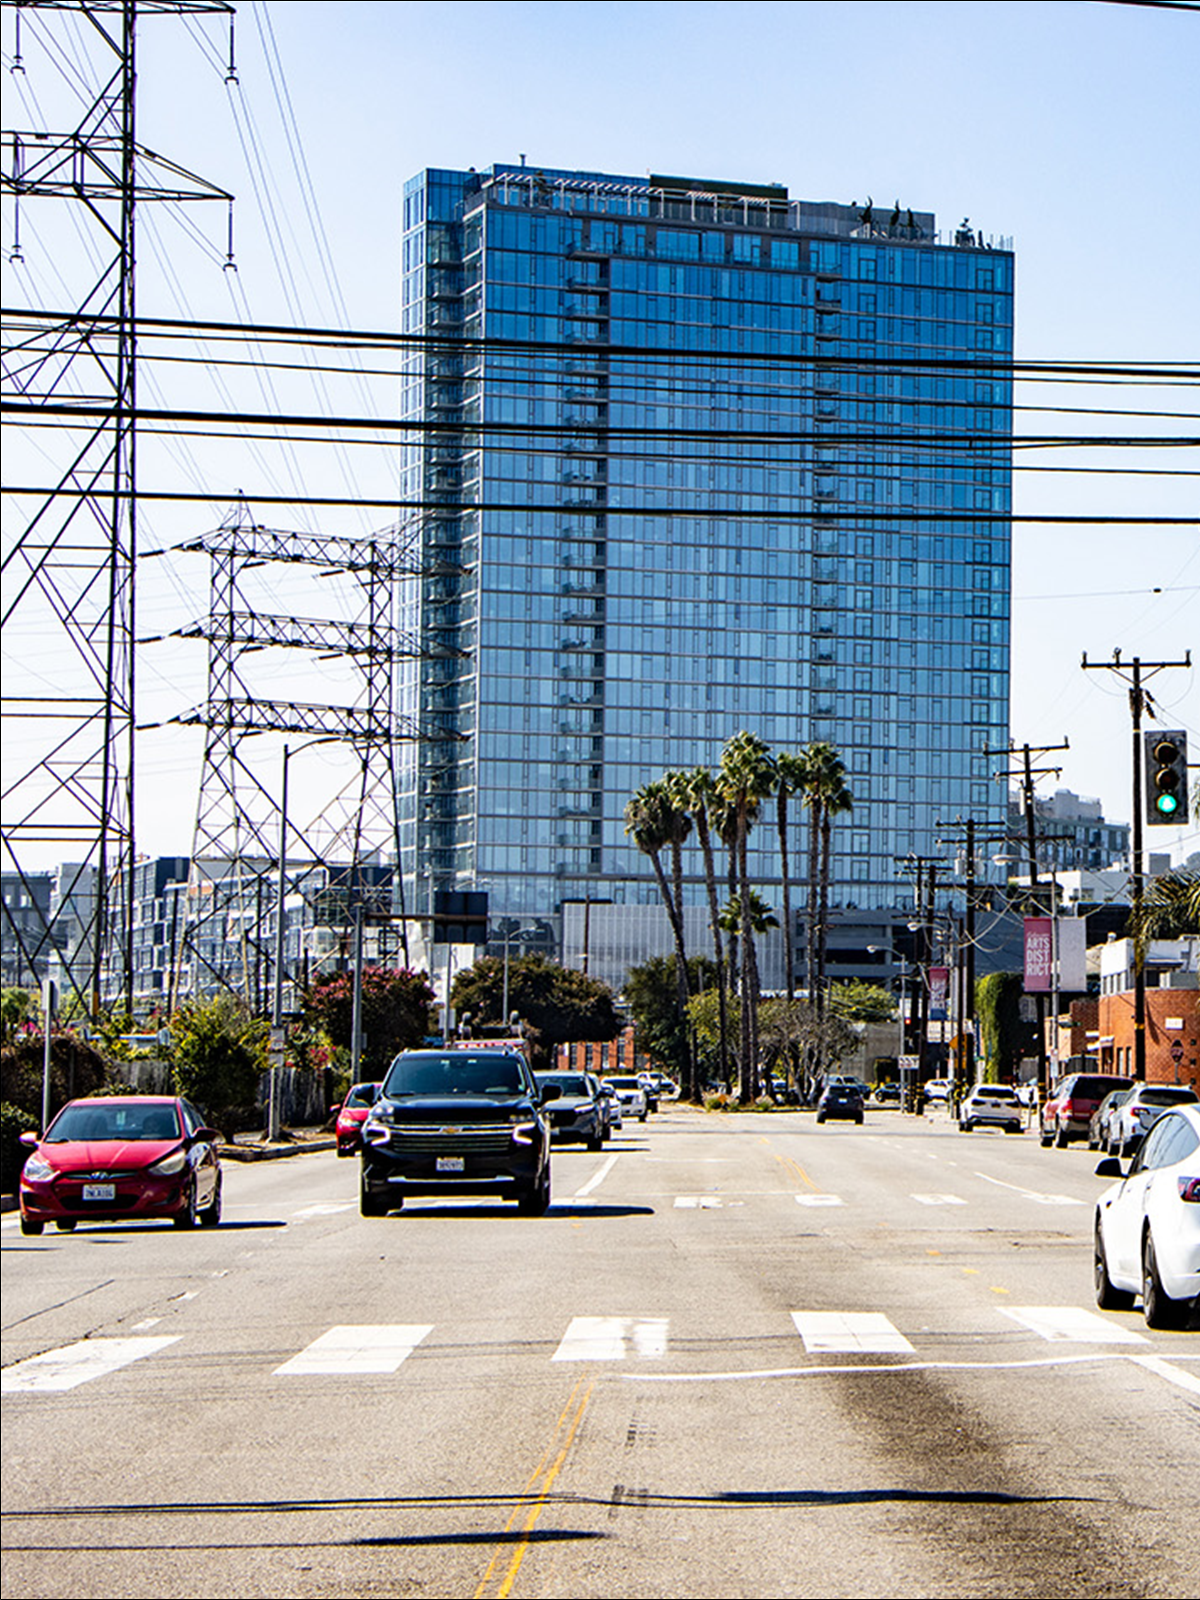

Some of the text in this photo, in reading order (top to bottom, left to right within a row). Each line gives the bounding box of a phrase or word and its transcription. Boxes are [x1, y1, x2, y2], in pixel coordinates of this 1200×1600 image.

[1027, 937, 1050, 949] ARTS
[1027, 949, 1050, 962] DIST
[1027, 963, 1050, 976] RICT
